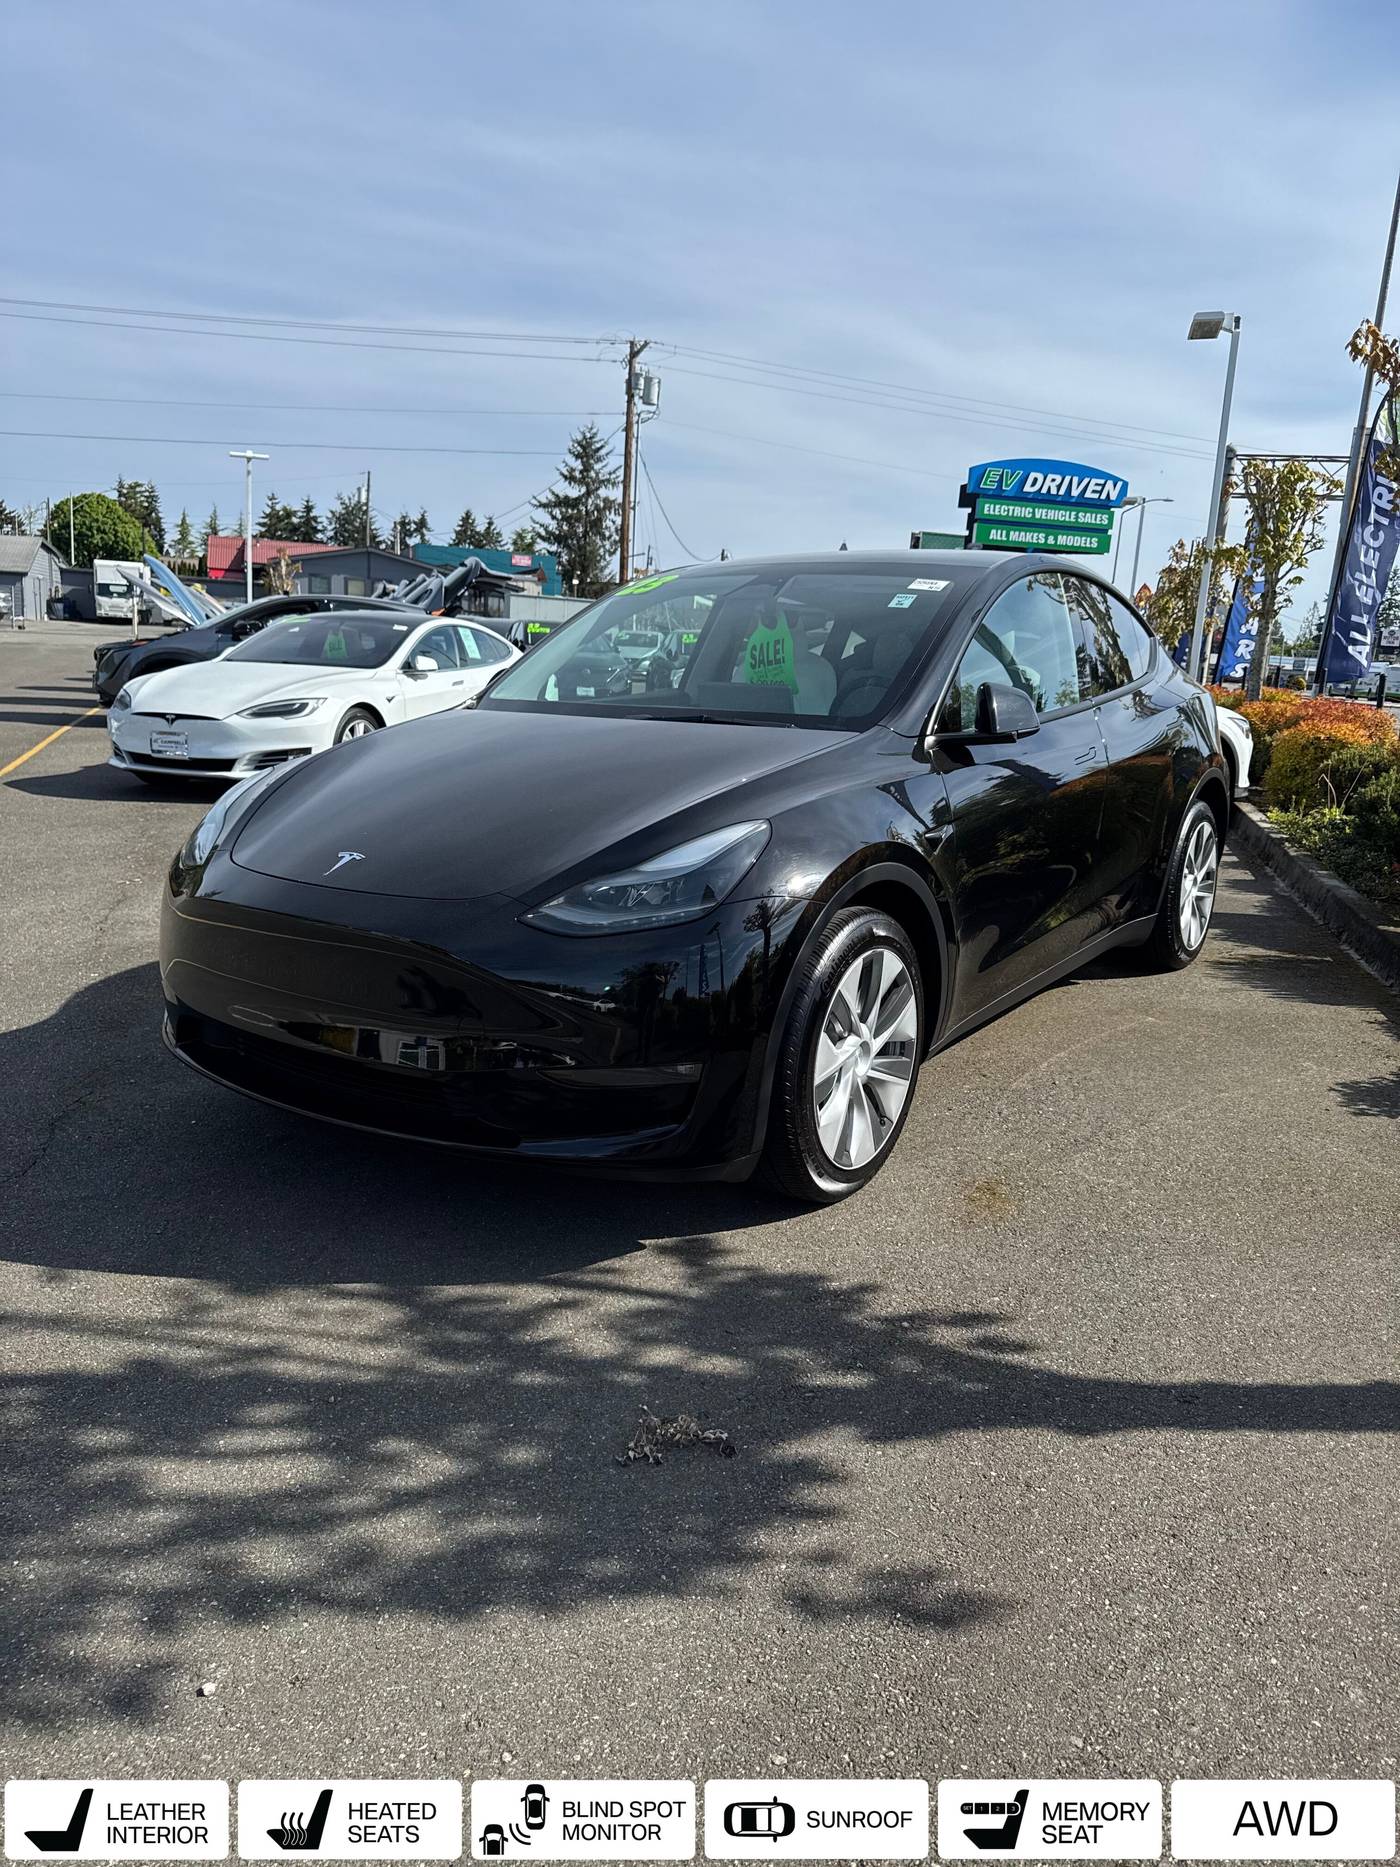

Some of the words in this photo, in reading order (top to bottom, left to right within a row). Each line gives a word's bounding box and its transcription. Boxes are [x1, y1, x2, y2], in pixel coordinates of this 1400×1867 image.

[980, 467, 1023, 490] EV
[1022, 471, 1124, 501] DRIVEN
[983, 503, 1033, 518] ELECTRIC
[1034, 508, 1076, 522] VEHICLE
[1077, 511, 1109, 525] SALES
[989, 528, 1008, 541] ALL
[1009, 531, 1046, 544] MAKES
[1047, 535, 1056, 545] &
[1057, 535, 1099, 548] MODELS
[749, 637, 785, 671] SALE!
[1347, 613, 1372, 668] ALL
